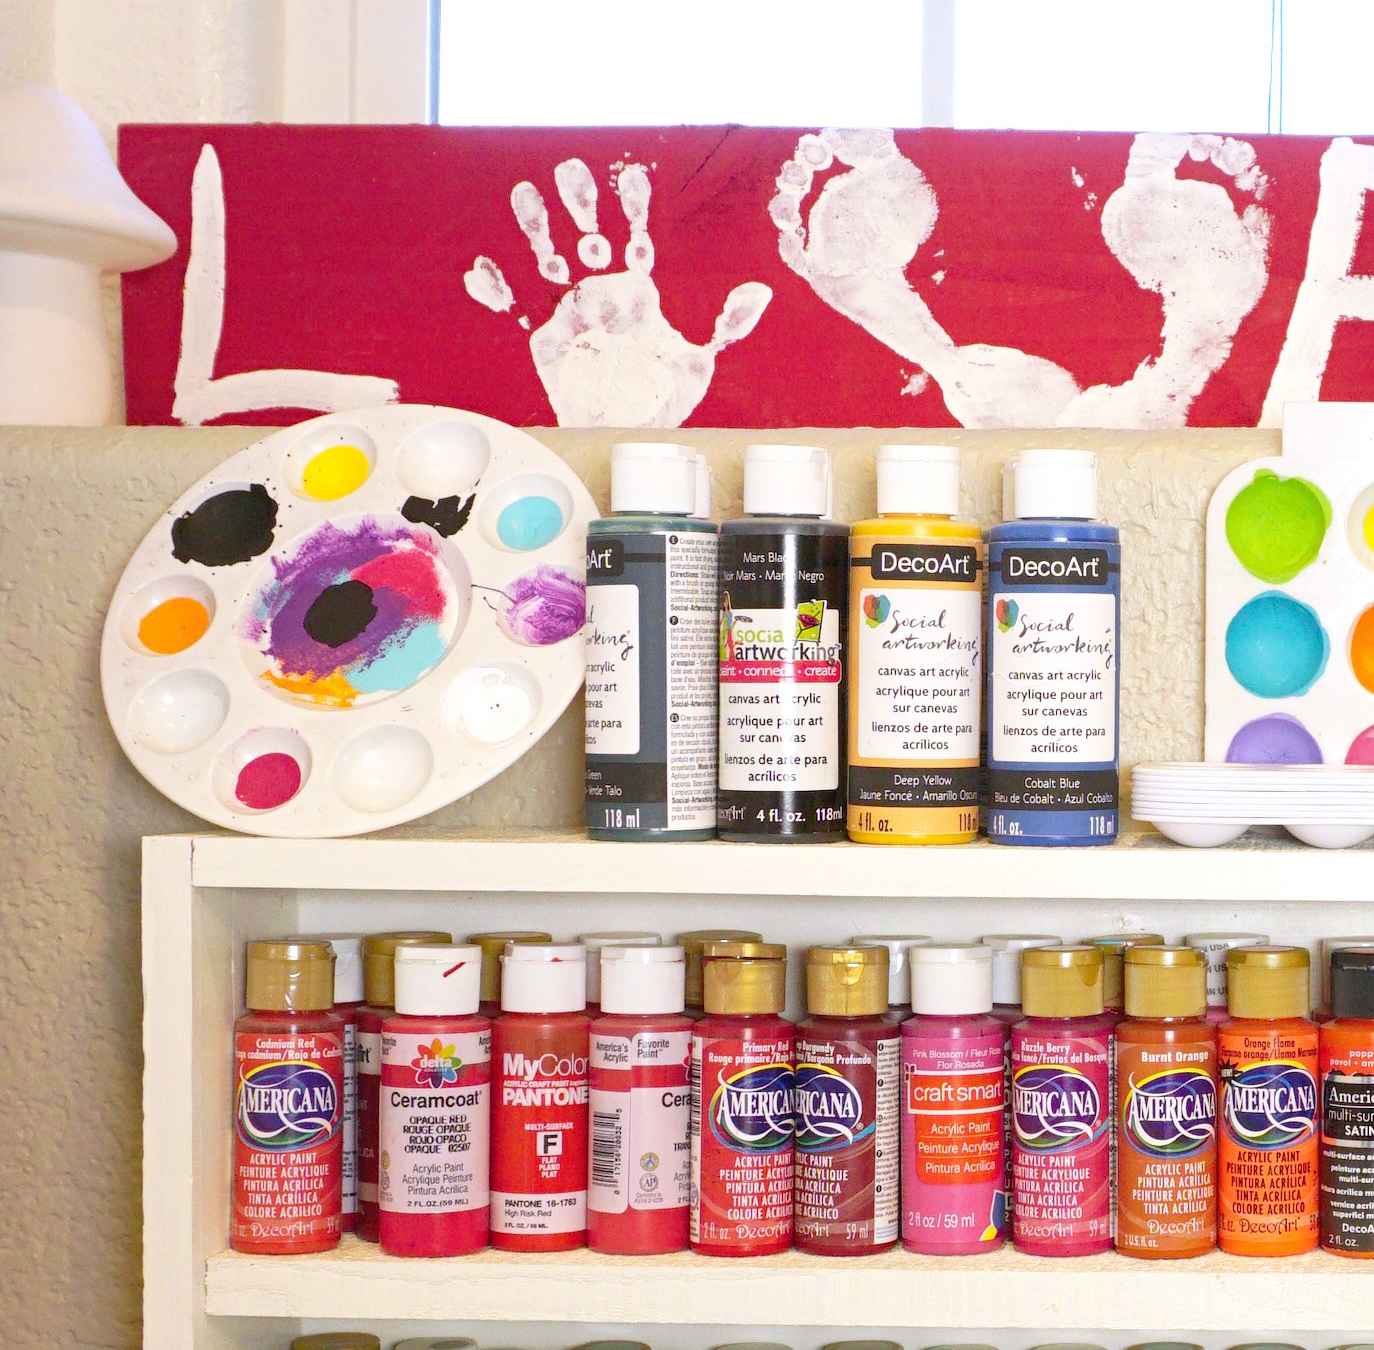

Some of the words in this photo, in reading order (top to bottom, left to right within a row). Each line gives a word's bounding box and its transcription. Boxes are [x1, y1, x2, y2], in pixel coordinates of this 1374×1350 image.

[743, 552, 765, 564] Mars
[881, 552, 970, 575] DecoArt
[1009, 555, 1099, 579] DecoArt
[798, 571, 824, 583] Negro
[892, 610, 947, 635] Social
[1019, 613, 1074, 639] Social
[804, 665, 837, 677] create
[878, 666, 915, 678] canvas
[919, 667, 935, 677] art
[938, 666, 969, 682] acrylic
[876, 685, 929, 699] acrylique
[932, 687, 956, 700] pour
[958, 687, 970, 697] art
[728, 694, 760, 705] canvas
[893, 703, 911, 714] sur
[913, 704, 957, 714] canevas
[872, 721, 906, 733] lienzos
[909, 722, 924, 733] de
[927, 722, 952, 733] arte
[955, 723, 972, 736] para
[902, 738, 949, 751] acrílicos
[894, 775, 919, 788] Deep
[923, 775, 952, 786] Yellow
[1025, 777, 1055, 789] Cobalt
[1059, 777, 1080, 789] Blue
[256, 1038, 295, 1049] Cadmium
[297, 1037, 315, 1048] Red
[596, 1042, 629, 1053] America's
[637, 1039, 670, 1049] Favorite
[420, 1055, 452, 1068] delta
[1141, 1051, 1172, 1062] Burnt
[1175, 1050, 1208, 1063] Orange
[503, 1053, 589, 1080] MyColor
[937, 1061, 954, 1069] Flor
[956, 1061, 984, 1069] Rosada
[503, 1087, 589, 1106] PANTONE
[914, 1083, 955, 1101] craft
[957, 1082, 1000, 1101] smart
[239, 1084, 334, 1119] AMERICANA
[391, 1091, 478, 1109] Ceramcoat
[409, 1115, 447, 1124] OPAQUE
[449, 1115, 467, 1124] RED
[931, 1122, 966, 1136] Acrylic
[969, 1122, 991, 1133] Paint
[543, 1135, 558, 1154] F
[250, 1154, 286, 1165] ACRYLIC
[290, 1153, 317, 1164] PAINT
[413, 1163, 442, 1174] Acrylic
[444, 1162, 464, 1172] Paint
[505, 1200, 542, 1208] PANTONE
[504, 1210, 519, 1218] High
